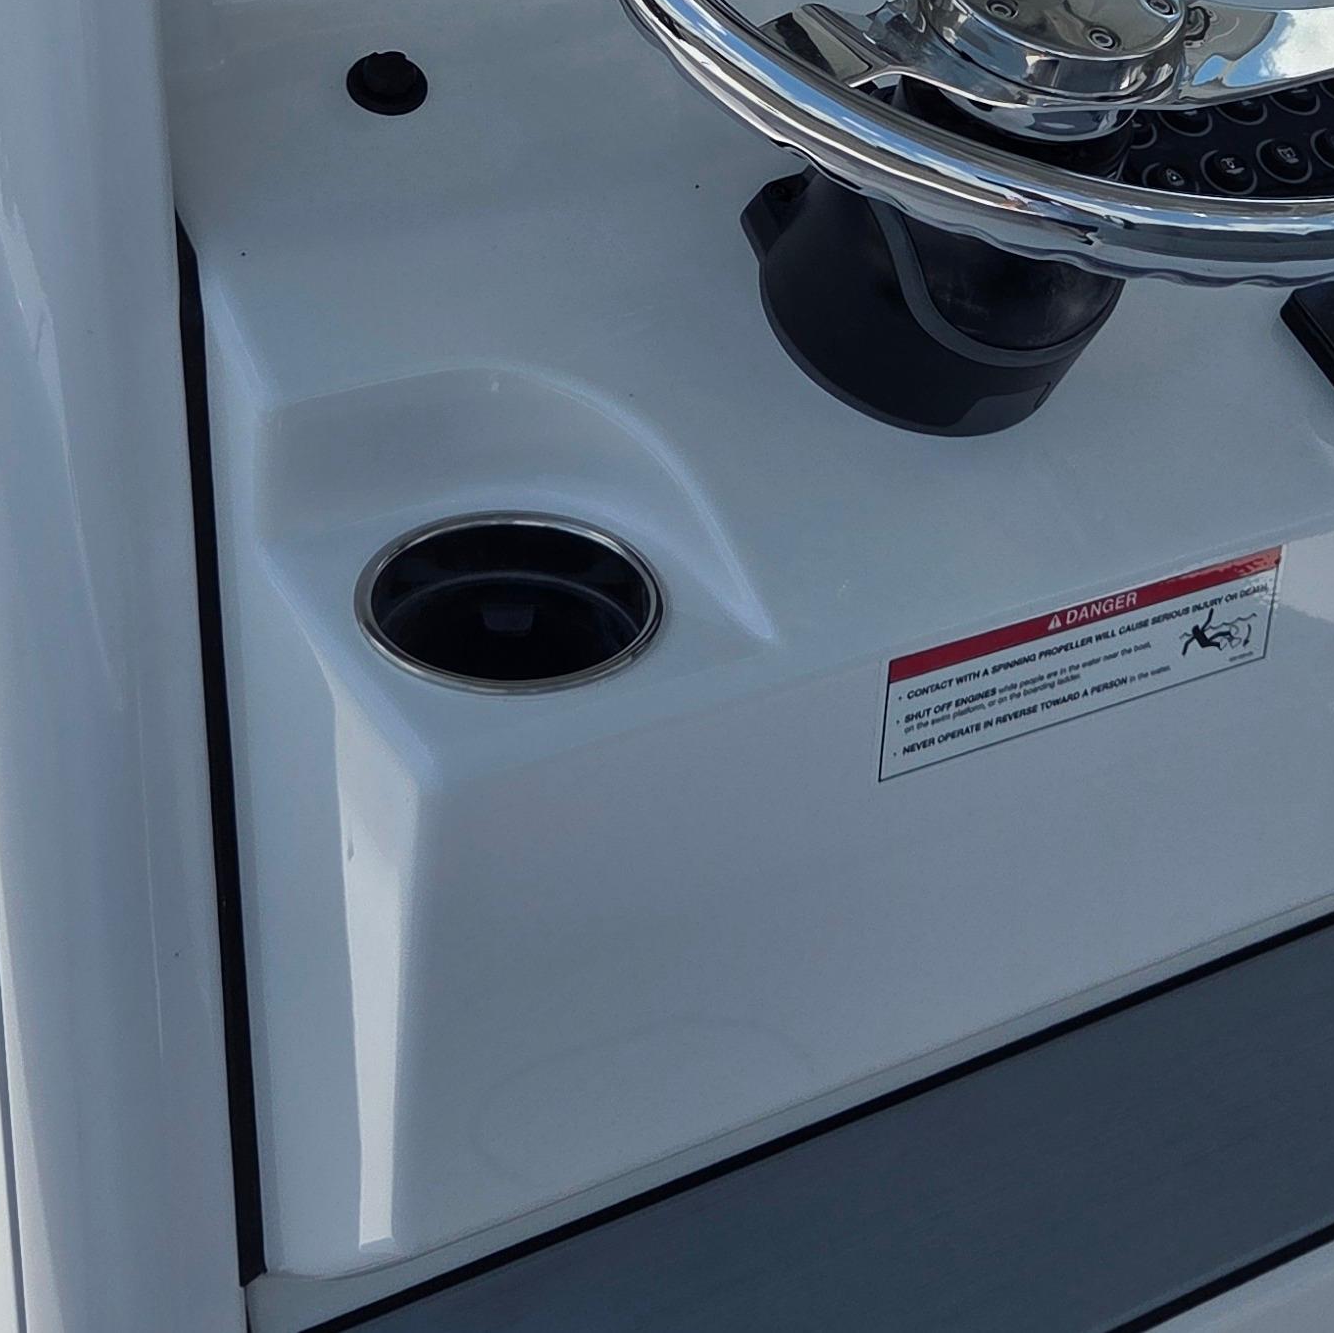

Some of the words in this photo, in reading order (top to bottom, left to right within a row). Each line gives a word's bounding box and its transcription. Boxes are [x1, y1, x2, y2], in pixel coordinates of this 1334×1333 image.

[906, 678, 954, 700] CONTACT
[955, 670, 980, 686] WITH
[981, 667, 989, 678] A
[991, 653, 1036, 675] SPINNING
[1038, 636, 1093, 660] PROPELLER
[1095, 628, 1116, 644] WILL
[1118, 618, 1149, 636] CAUSE
[1151, 607, 1191, 626] SERIOUS
[1191, 594, 1223, 615] INJURY
[1225, 591, 1238, 604] OR
[1066, 591, 1139, 626] DANGER
[902, 736, 935, 756] NEVER
[937, 723, 982, 744] OPERATE
[983, 718, 994, 730] IN
[995, 705, 1039, 726] REVERSE
[1040, 692, 1080, 711] TOWARD
[1081, 688, 1089, 699] A
[1090, 677, 1127, 695] PERSON
[1129, 674, 1137, 684] in
[1137, 670, 1150, 680] the
[903, 725, 915, 735] on
[916, 719, 930, 731] the
[988, 700, 997, 708] or
[997, 696, 1007, 705] on
[1009, 691, 1021, 702] the
[1023, 680, 1056, 698] boarding
[904, 707, 932, 724] SHUT
[933, 701, 953, 716] OFF
[954, 686, 997, 710] ENGINES
[998, 680, 1017, 694] while
[1019, 674, 1045, 690] people
[1046, 670, 1059, 680] are
[1061, 666, 1067, 676] in
[1068, 662, 1080, 673] the
[1121, 646, 1133, 658] the
